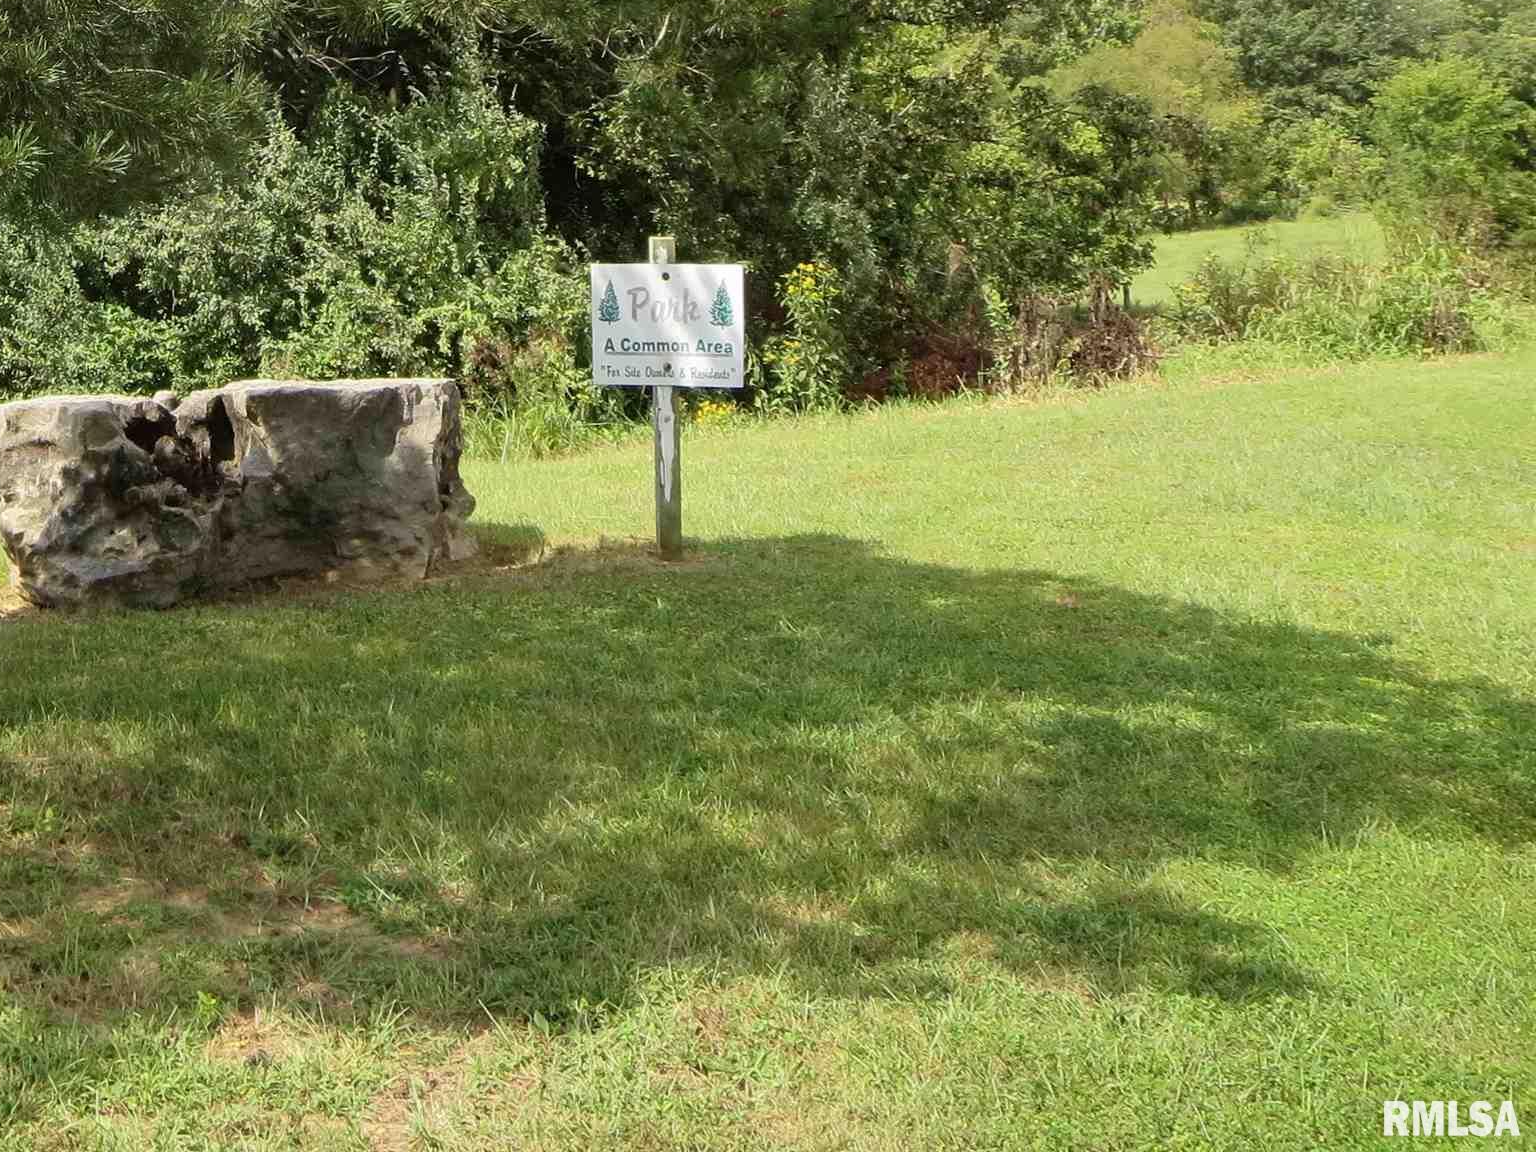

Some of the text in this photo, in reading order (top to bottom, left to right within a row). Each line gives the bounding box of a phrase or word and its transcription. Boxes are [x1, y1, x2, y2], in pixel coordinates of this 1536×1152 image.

[626, 286, 703, 324] Park
[604, 338, 734, 354] A Common Area
